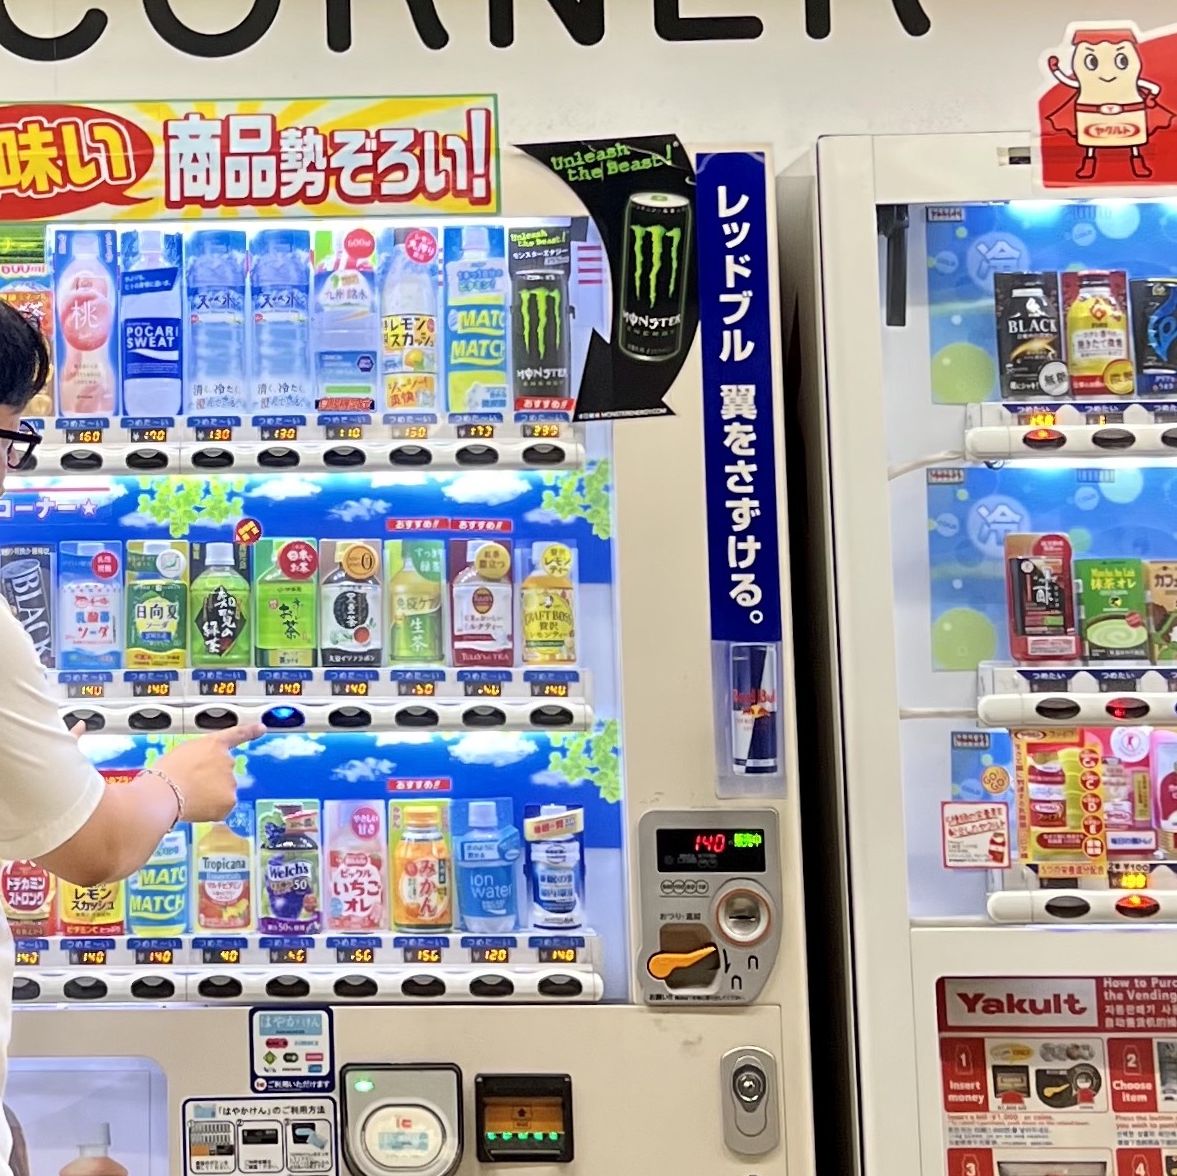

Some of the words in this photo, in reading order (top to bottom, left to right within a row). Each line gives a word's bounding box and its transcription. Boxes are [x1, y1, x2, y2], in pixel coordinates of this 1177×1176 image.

[1093, 125, 1132, 136] ヤクルト
[166, 109, 492, 206] 商品勢ぞろい!
[550, 142, 631, 171] Unleash
[567, 165, 596, 182] the
[606, 143, 674, 177] Beast!
[511, 230, 548, 242] Unleash
[717, 185, 756, 363] レッドブル
[70, 300, 100, 331] 桃
[622, 312, 682, 330] MONSTER
[390, 316, 426, 332] レモン
[1007, 318, 1058, 334] BLACK
[126, 325, 179, 338] POCARI
[126, 337, 176, 349] SWEAT
[389, 332, 436, 348] スカッシュ
[516, 367, 568, 380] MONSTER
[718, 384, 765, 626] 翼をさずける。
[395, 520, 439, 530] おすすめ!!
[458, 520, 504, 531] おすすめ!!
[544, 556, 572, 566] レモン
[135, 604, 179, 621] 日向夏
[409, 617, 428, 652] 生茶
[395, 779, 442, 791] おすすめ!!
[695, 833, 726, 853] 140
[202, 856, 246, 871] Tropicana
[269, 862, 309, 880] Welch's
[340, 868, 372, 879] ビックル
[470, 873, 494, 887] ion
[74, 888, 112, 900] レモン
[333, 879, 382, 897] いちご
[419, 859, 436, 918] みかん
[471, 882, 513, 899] water
[7, 891, 45, 906] ストロング
[71, 900, 115, 912] スカッシュ
[343, 899, 371, 913] オレ
[1103, 977, 1130, 988] How
[1134, 977, 1147, 988] to
[1104, 989, 1124, 1001] the
[1127, 989, 1177, 1003] Vending
[956, 992, 1089, 1016] Yakult
[260, 1015, 321, 1029] はやかけん
[959, 1053, 967, 1067] 1
[1126, 1053, 1137, 1068] 2
[949, 1080, 981, 1091] Insert
[1112, 1080, 1153, 1091] Choose
[948, 1093, 985, 1105] money
[1122, 1091, 1148, 1102] item
[218, 1105, 326, 1117] 「はやかけん」のご利用方法
[966, 1163, 977, 1176] 3
[1134, 1163, 1146, 1176] 4
